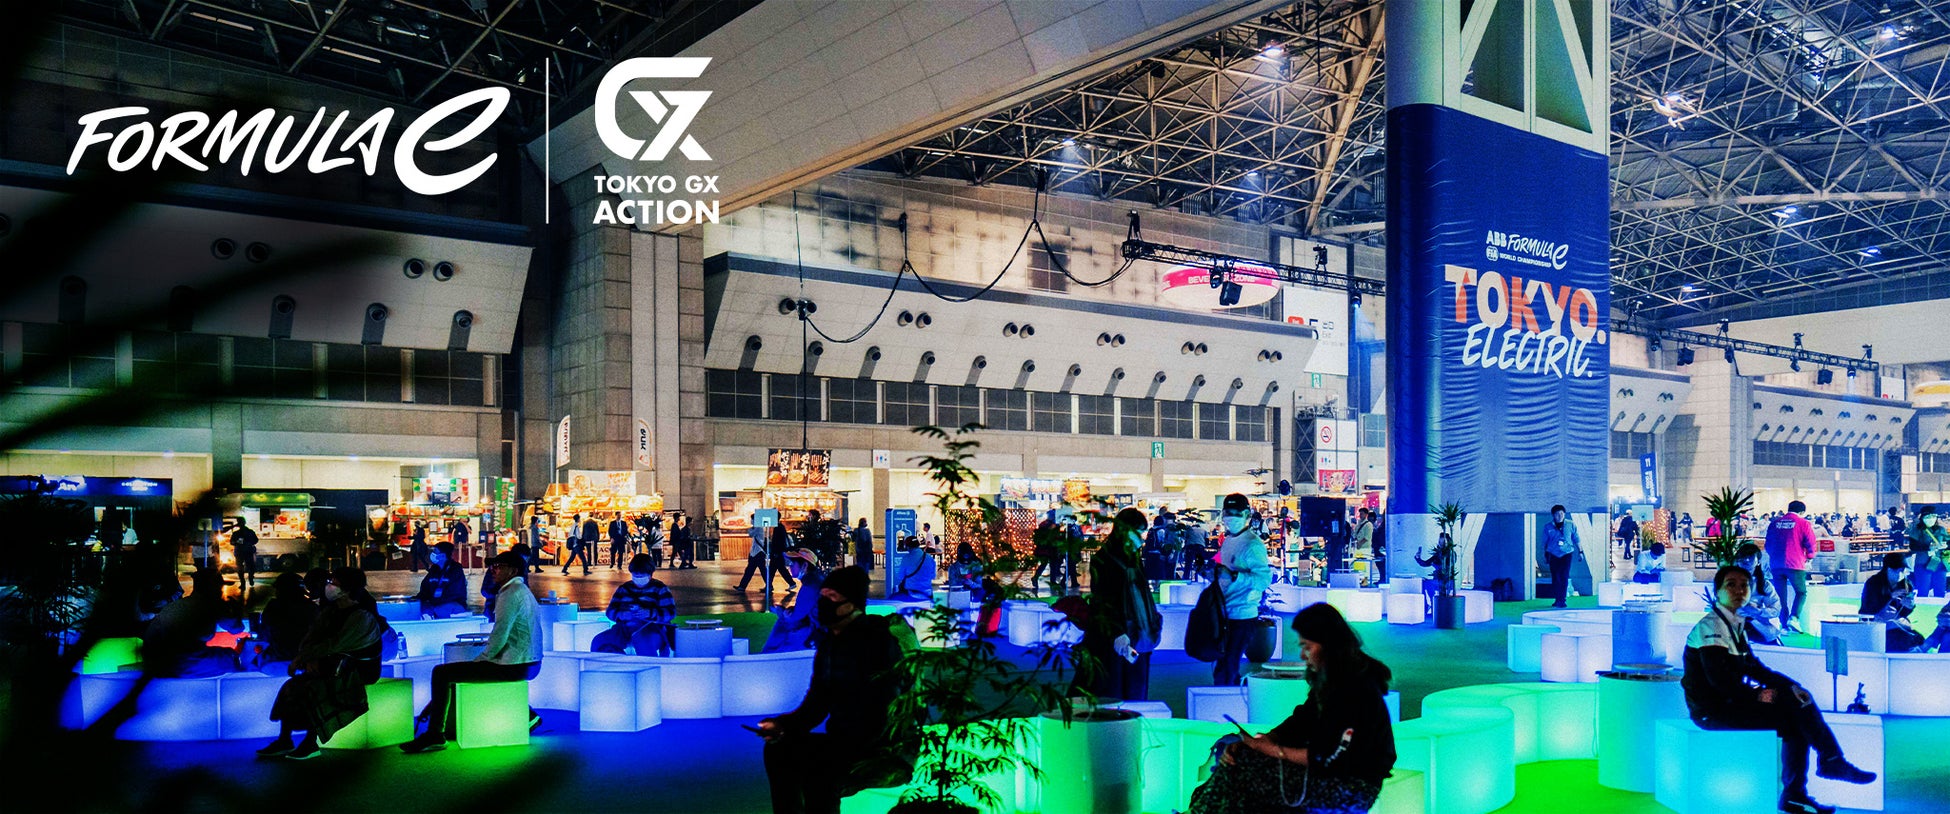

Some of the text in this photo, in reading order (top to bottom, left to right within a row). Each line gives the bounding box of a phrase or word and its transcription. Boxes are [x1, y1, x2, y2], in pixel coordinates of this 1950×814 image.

[1486, 230, 1507, 247] ABB
[1507, 233, 1555, 260] FORMULA
[1499, 253, 1516, 261] WORLD
[1517, 256, 1552, 268] CHAMPIONSHIP
[1462, 322, 1593, 379] ELECTRIC.
